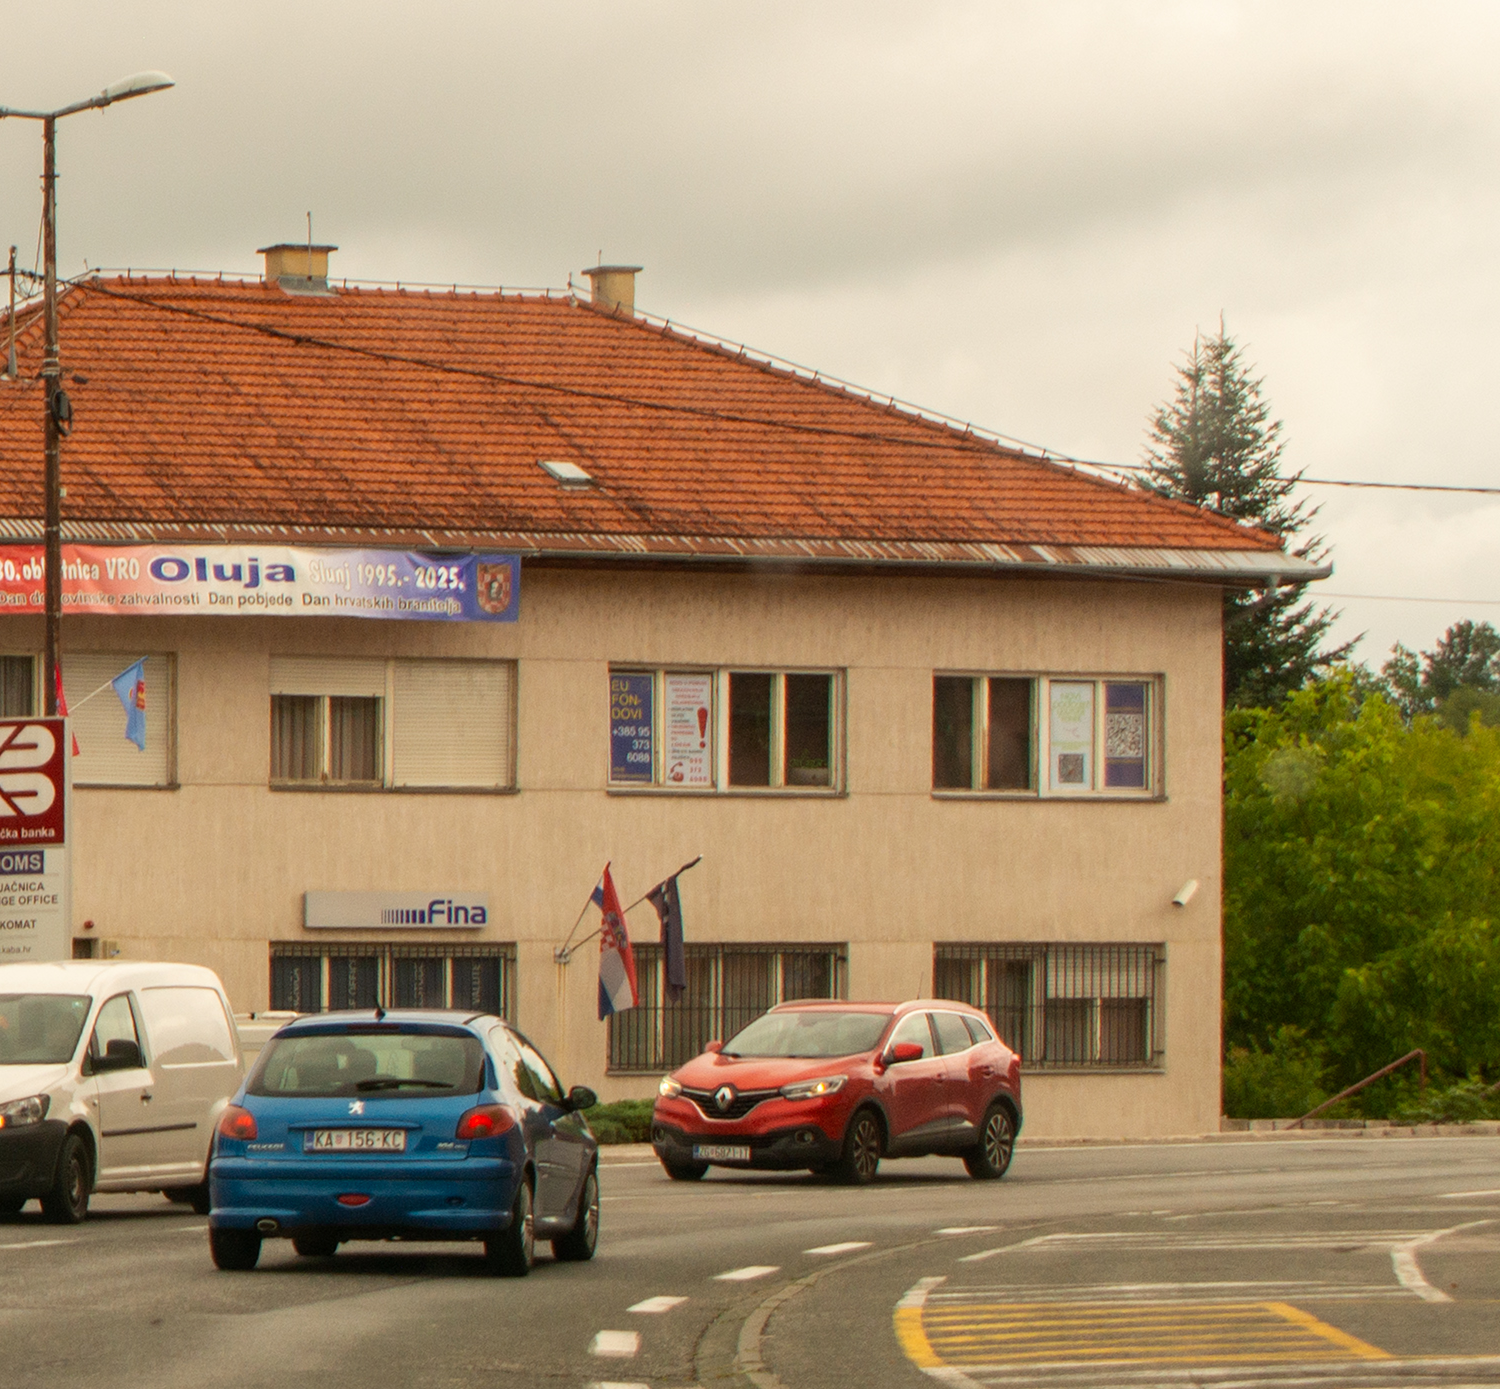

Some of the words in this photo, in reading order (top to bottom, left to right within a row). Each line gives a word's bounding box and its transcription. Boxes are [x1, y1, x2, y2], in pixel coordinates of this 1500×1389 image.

[22, 556, 100, 581] obltnica
[105, 557, 140, 581] VRO
[148, 556, 297, 589] Oluja
[308, 559, 352, 590] Slunj
[414, 566, 466, 591] 2025.
[30, 589, 116, 607] doovinske
[119, 591, 200, 606] zahvalnosti
[208, 592, 234, 606] Dan
[238, 592, 293, 608] pobjede
[302, 593, 331, 607] Dan
[334, 593, 394, 610] hrvatskih
[398, 595, 462, 614] branitelja
[611, 680, 629, 692] EU
[611, 693, 642, 706] FON-
[611, 707, 642, 720] DOVI
[612, 725, 637, 737] +385
[632, 739, 650, 750] 373
[21, 827, 55, 838] banka
[18, 894, 58, 906] OFFICE
[315, 1131, 334, 1147] KA
